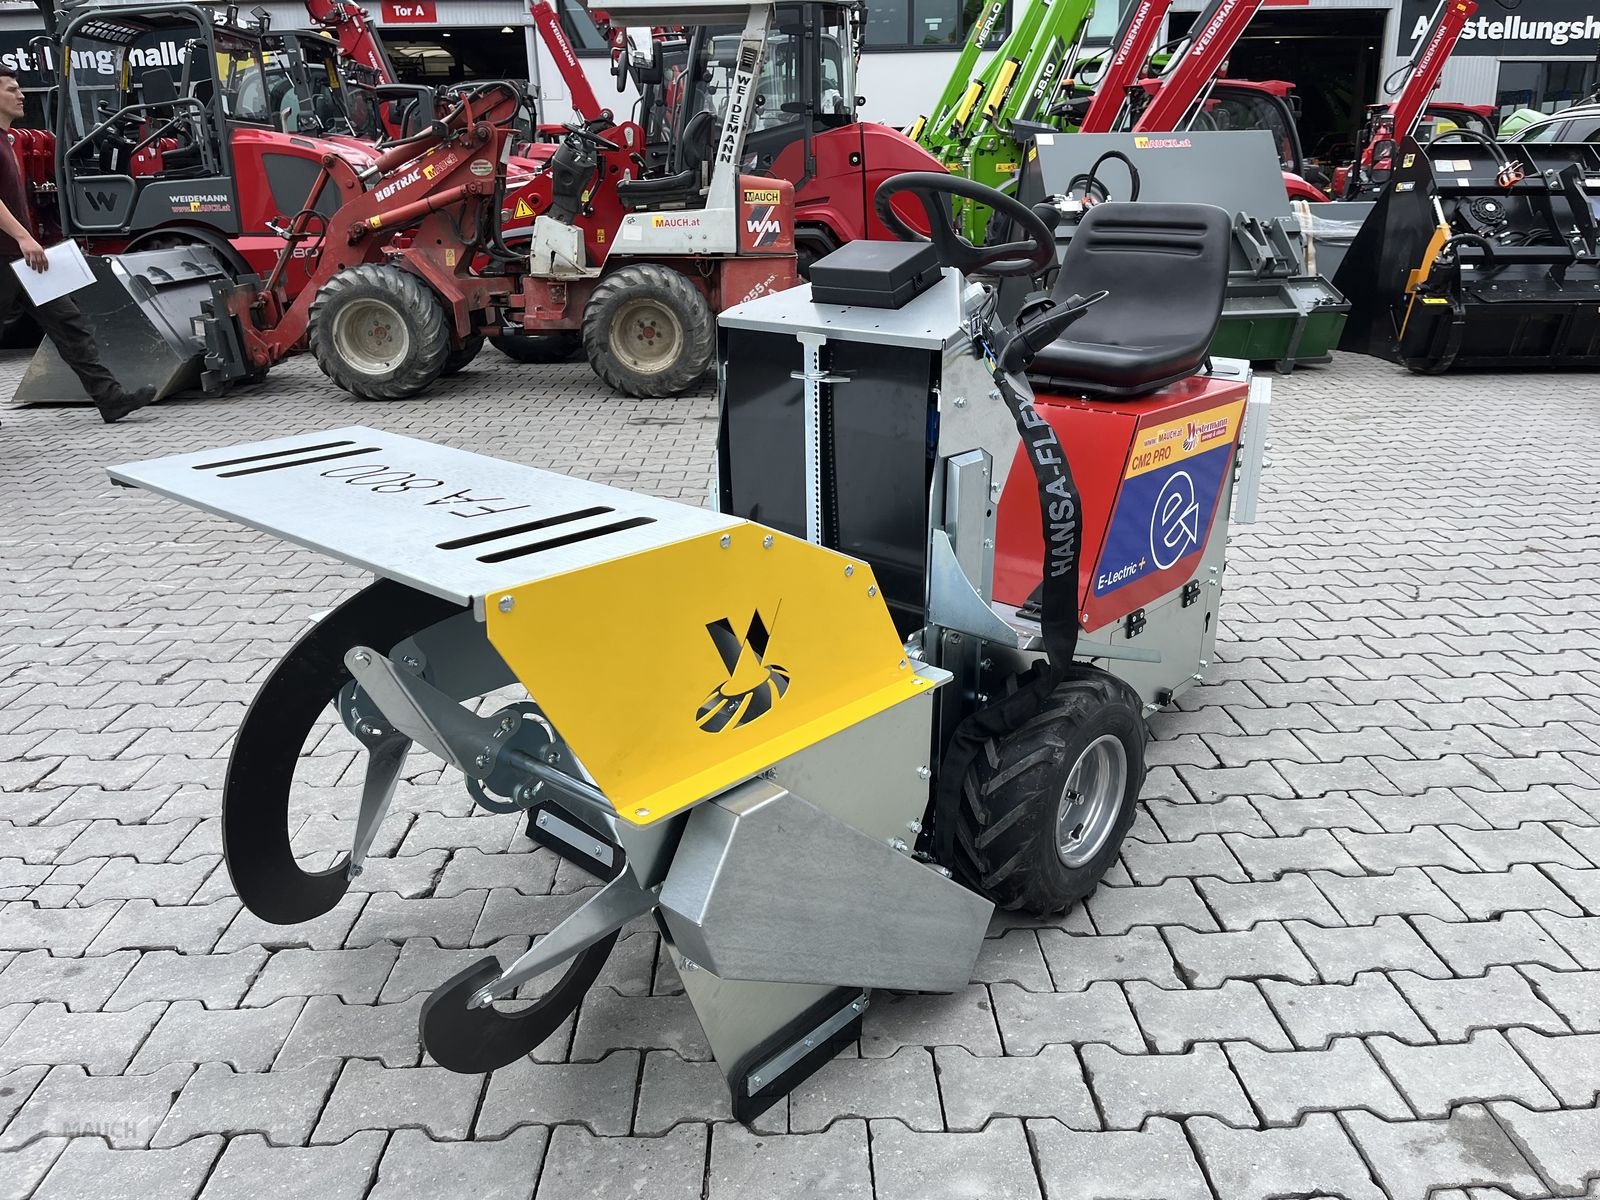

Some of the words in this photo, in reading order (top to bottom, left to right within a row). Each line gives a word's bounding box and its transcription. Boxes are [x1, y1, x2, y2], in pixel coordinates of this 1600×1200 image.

[393, 6, 412, 16] Tor
[416, 5, 424, 16] A
[975, 2, 1002, 49] MERLO
[549, 19, 576, 67] WEIDEMANN
[1115, 1, 1151, 66] WEIDEMANN
[1411, 15, 1600, 46] Astellungsh
[1415, 25, 1447, 79] WEIDEMANN
[1034, 62, 1056, 99] 38.10
[720, 74, 751, 163] WEIDEMANN
[375, 167, 422, 202] HOFTRAC
[427, 153, 458, 178] MAUCH
[169, 194, 228, 203] WEIDEMANN
[746, 191, 779, 203] MAUCH
[655, 218, 700, 228] MAUCH.at
[1132, 451, 1153, 470] CM2
[1153, 445, 1172, 464] PRO
[319, 464, 445, 493] 800
[1015, 393, 1075, 577] HANSA-FLEX
[424, 488, 532, 518] FA
[1097, 562, 1138, 590] E-Lectric
